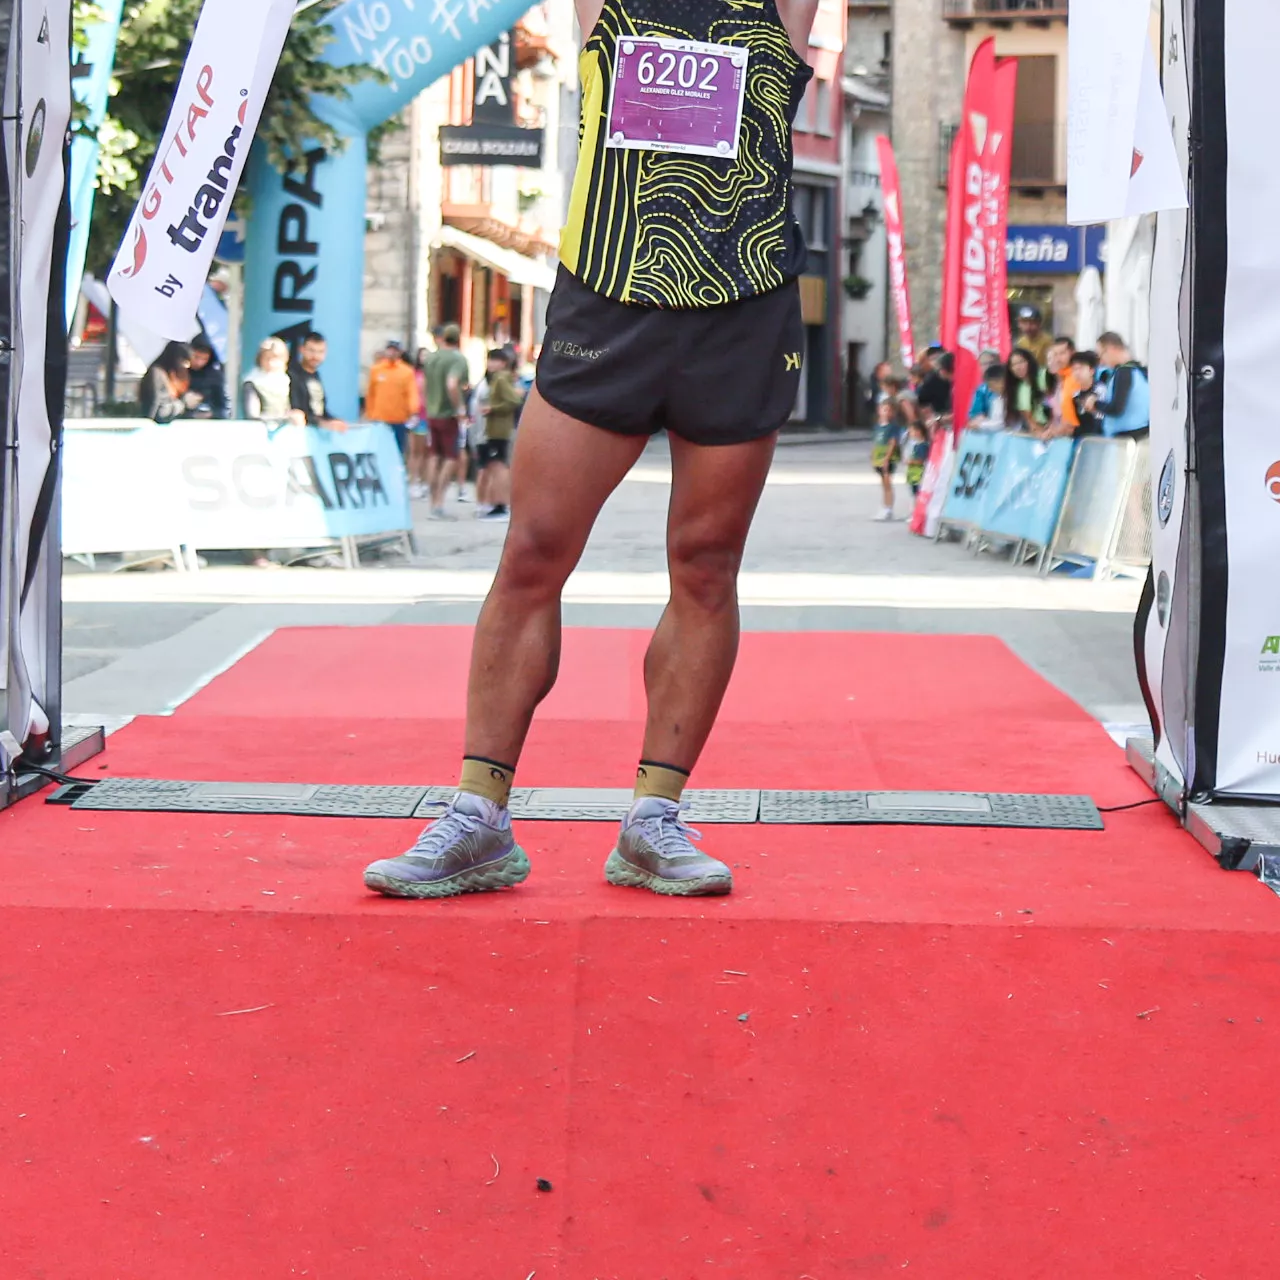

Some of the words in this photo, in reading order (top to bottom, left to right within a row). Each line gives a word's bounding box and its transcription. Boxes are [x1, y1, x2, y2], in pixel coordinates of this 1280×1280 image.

[342, 1, 392, 56] NO
[637, 52, 719, 91] 6202
[640, 87, 670, 95] ALEXANDER
[685, 90, 710, 99] MORALES
[142, 64, 214, 221] GTTAP
[155, 273, 183, 298] by
